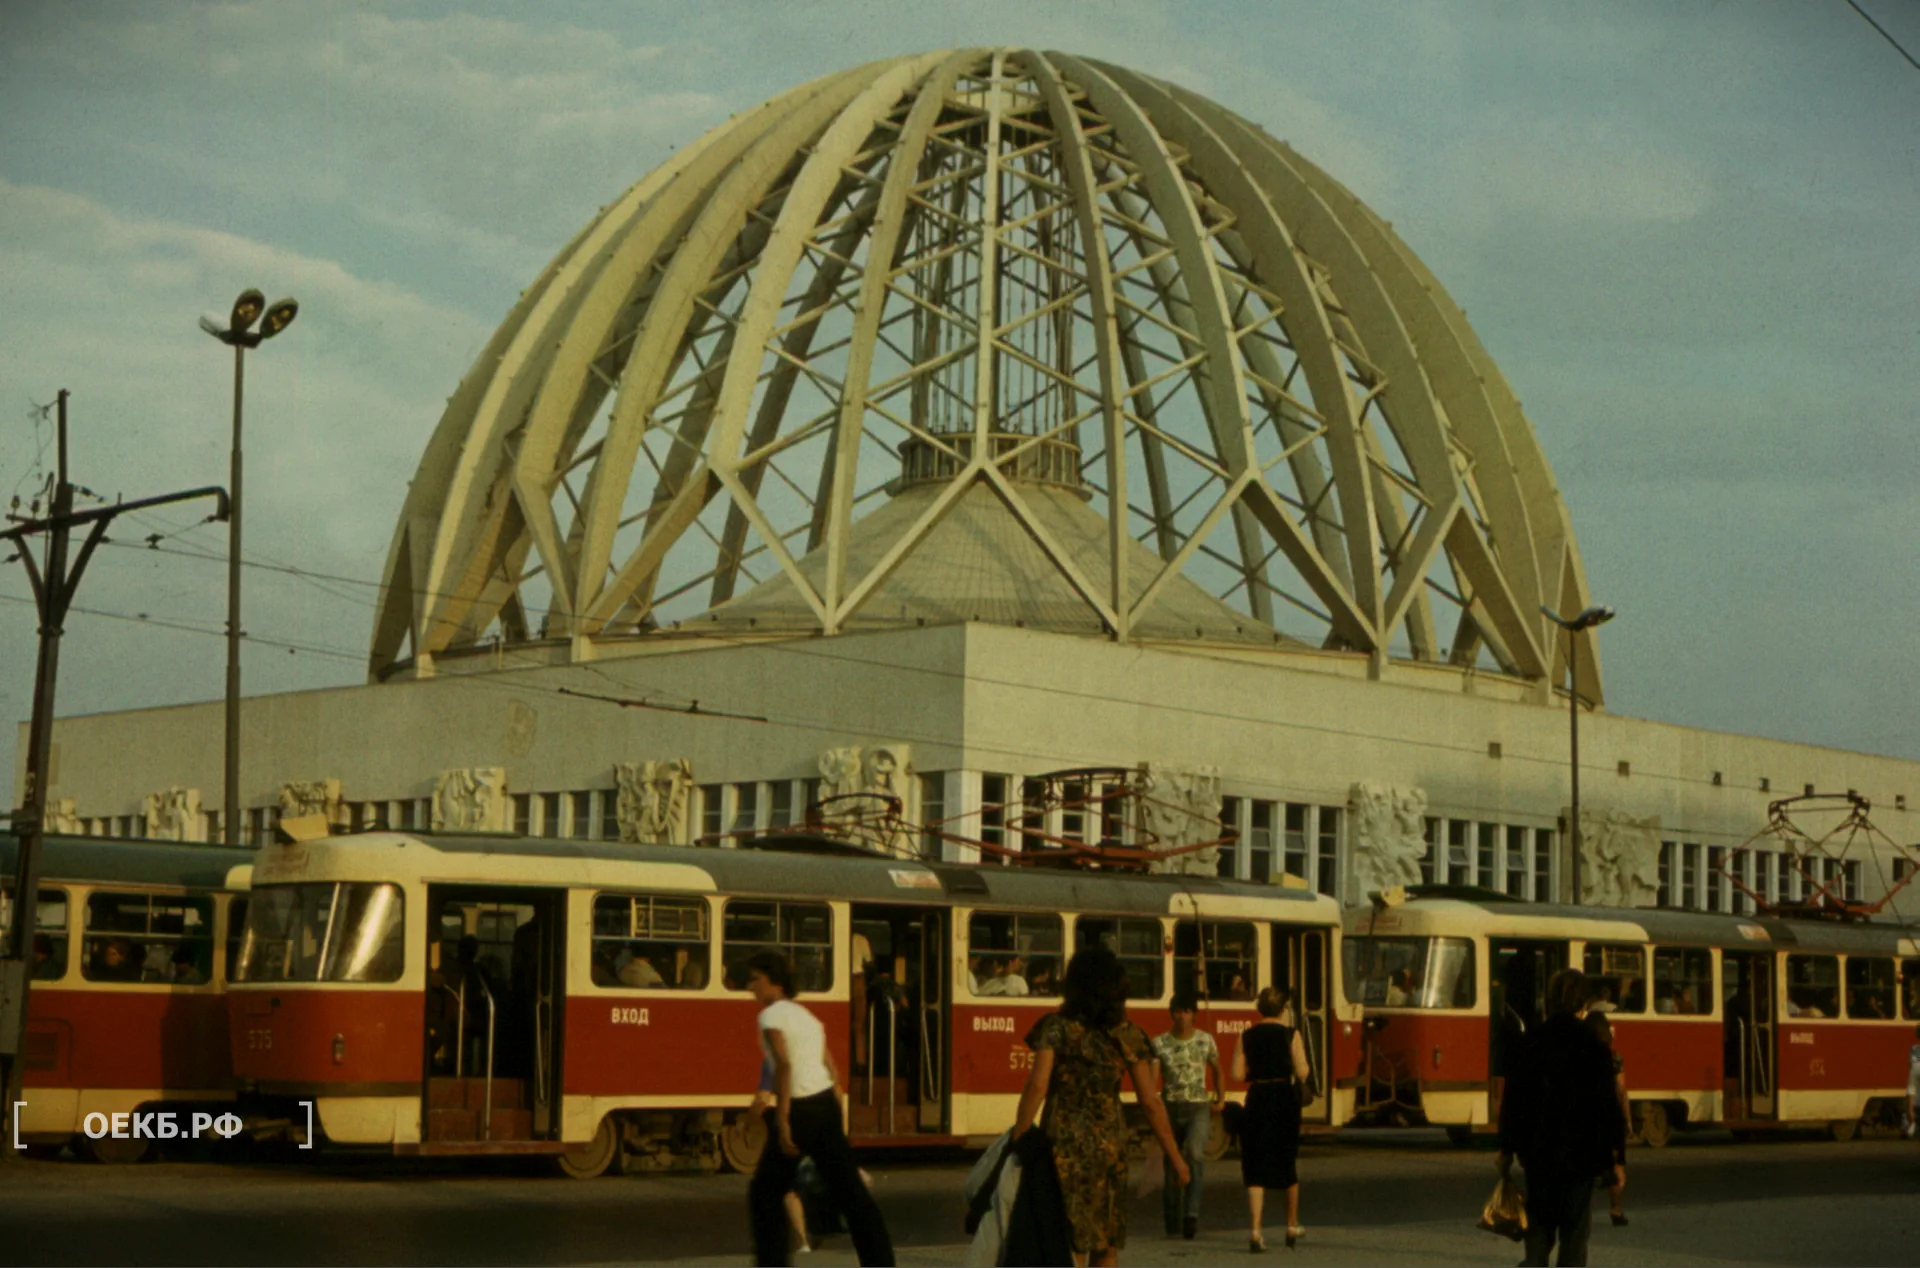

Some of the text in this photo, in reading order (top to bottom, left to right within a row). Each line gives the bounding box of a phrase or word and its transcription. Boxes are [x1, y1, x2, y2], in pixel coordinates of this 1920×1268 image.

[611, 1007, 649, 1027] ВХОД
[973, 1016, 1015, 1033] ВЫХОД
[248, 1029, 273, 1051] 575
